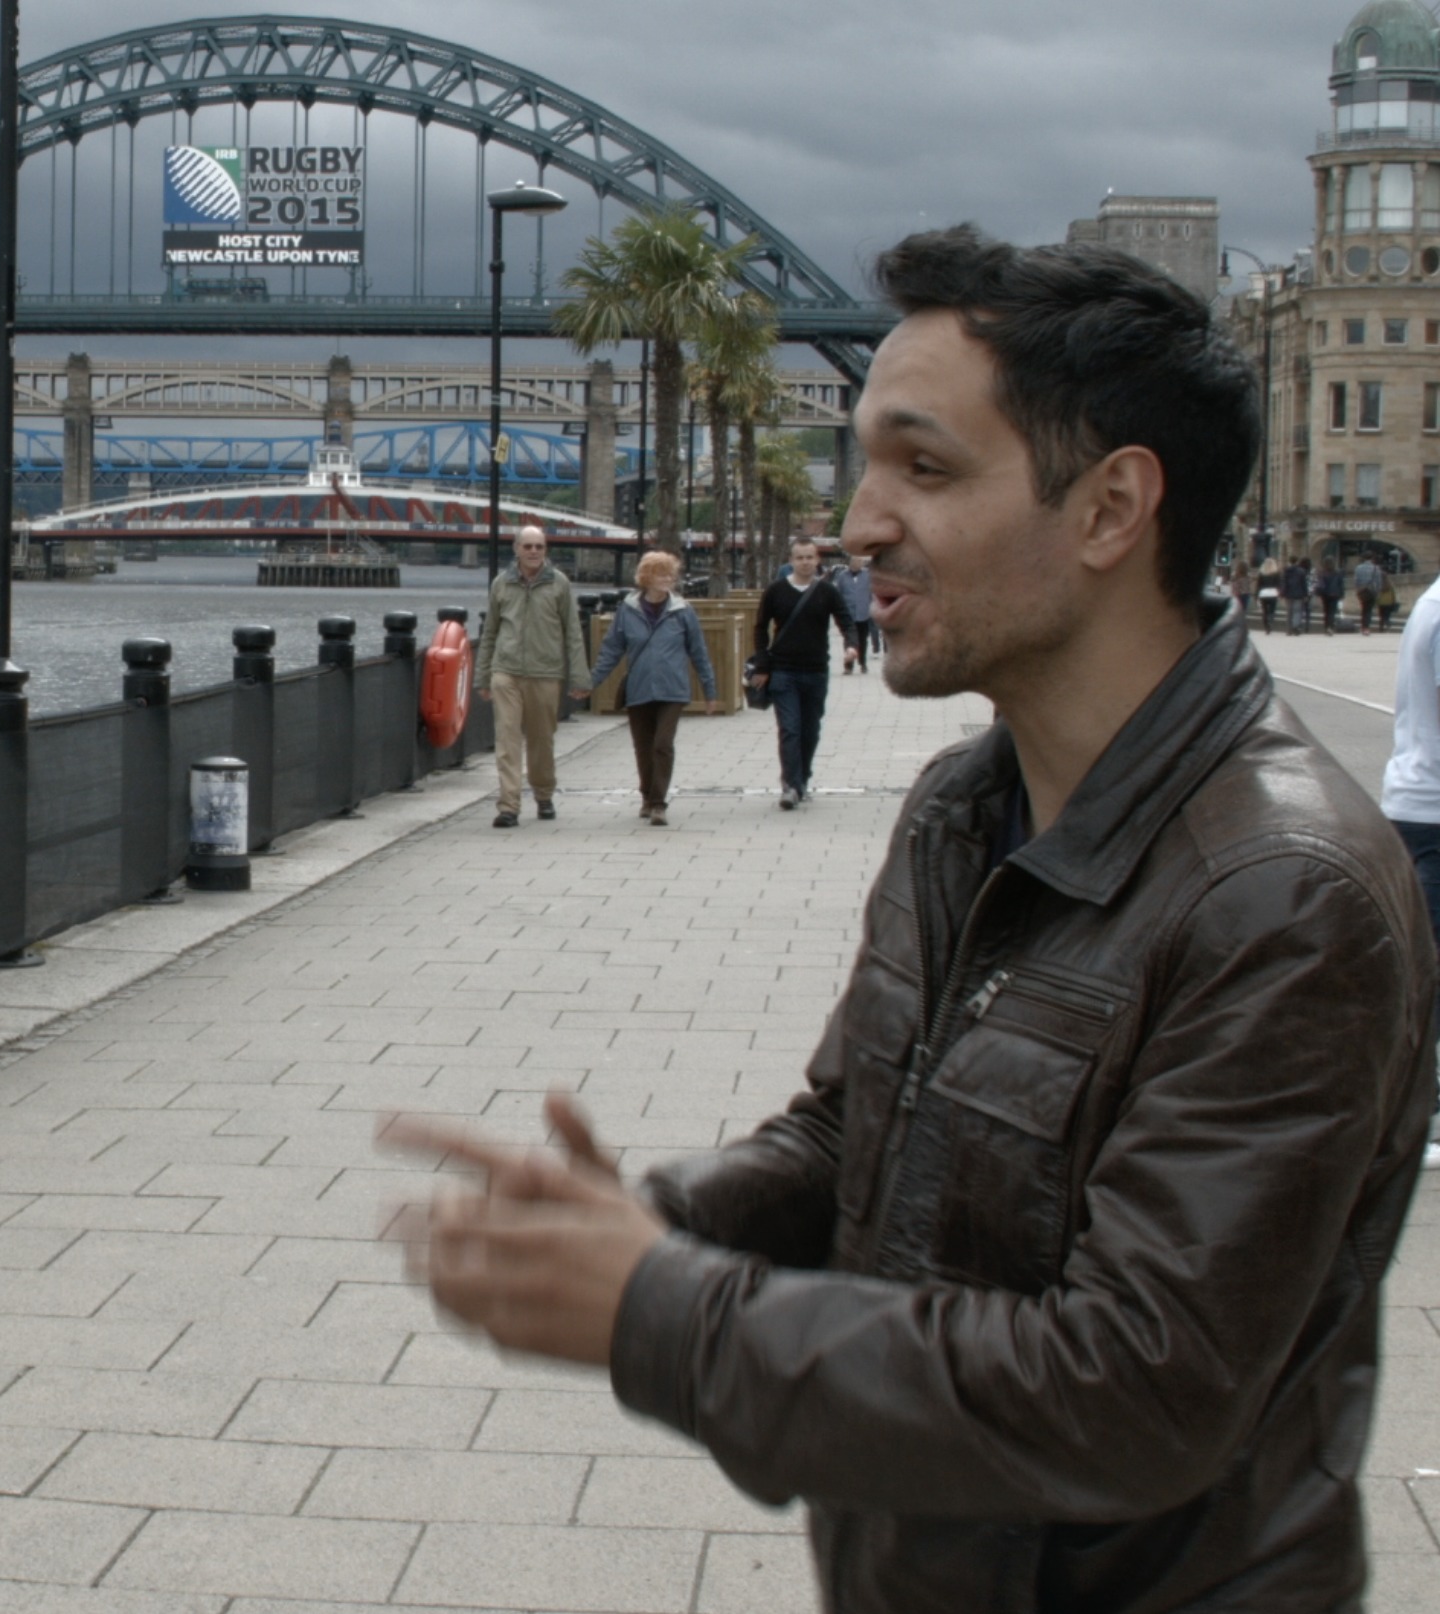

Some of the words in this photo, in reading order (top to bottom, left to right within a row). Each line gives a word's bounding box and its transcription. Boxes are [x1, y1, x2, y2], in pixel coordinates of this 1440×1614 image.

[215, 149, 238, 159] IRB
[249, 147, 363, 174] RUGBY
[249, 178, 319, 193] WORLD
[323, 178, 362, 193] CUP
[248, 196, 360, 225] 2015
[218, 234, 262, 248] HOST
[265, 234, 303, 248] CITY
[166, 250, 264, 263] NEWCASTLE
[266, 250, 313, 263] UPON
[316, 250, 360, 263] TYNE
[1345, 520, 1396, 532] COFFEE
